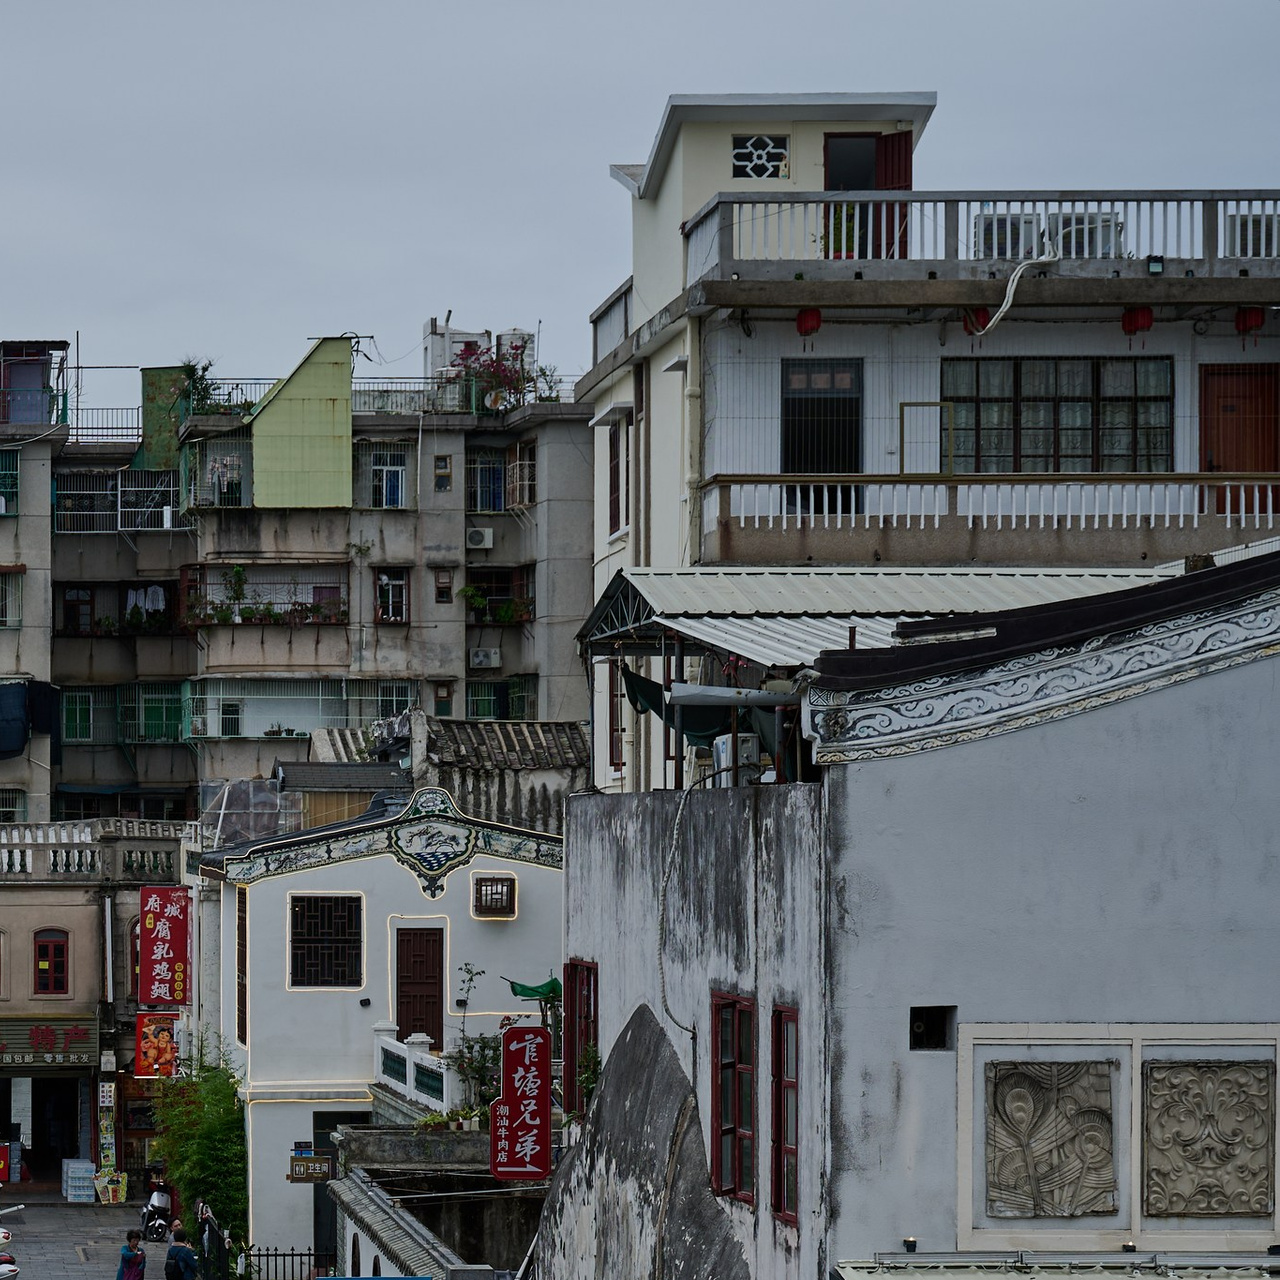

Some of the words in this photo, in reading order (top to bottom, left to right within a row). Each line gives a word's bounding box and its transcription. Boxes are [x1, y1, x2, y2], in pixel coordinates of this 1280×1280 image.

[150, 917, 174, 1000] 腐乳鸡翅
[28, 1024, 90, 1050] 特产
[69, 1053, 90, 1063] 批发
[496, 1105, 509, 1163] 潮汕牛肉店
[307, 1163, 329, 1173] 卫生间
